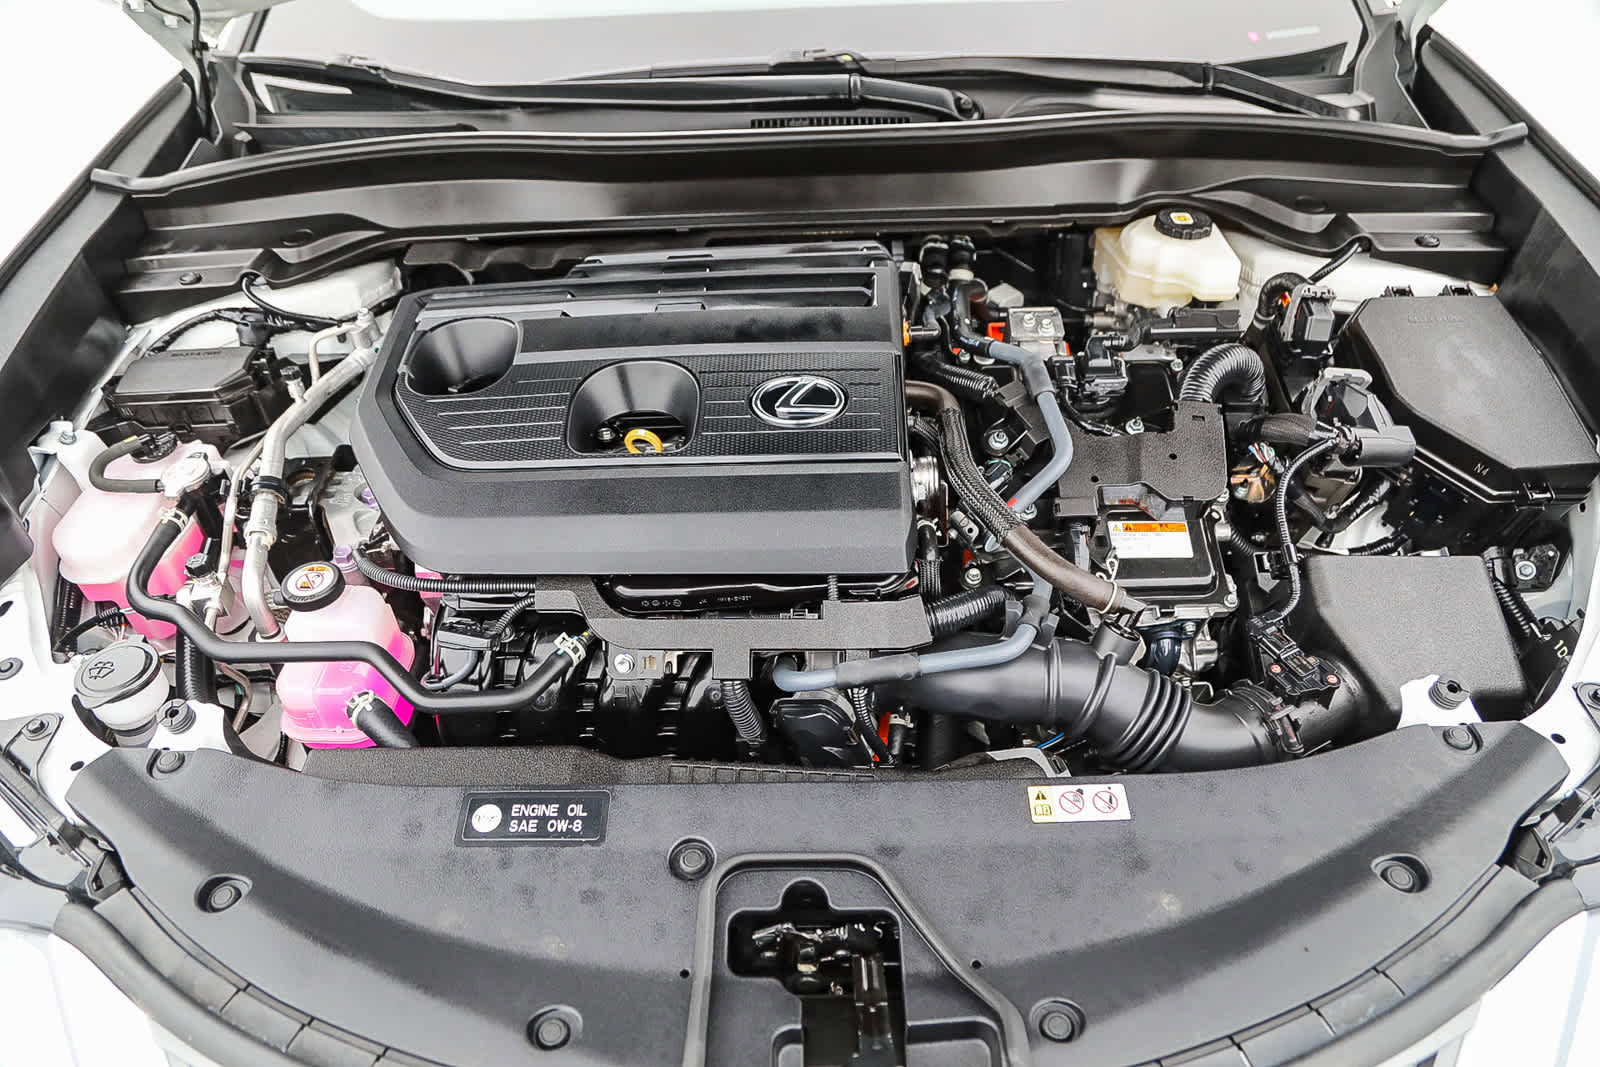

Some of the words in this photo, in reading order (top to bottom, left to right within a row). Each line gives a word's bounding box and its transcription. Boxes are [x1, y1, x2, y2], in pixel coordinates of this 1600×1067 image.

[511, 803, 559, 817] ENGINE
[567, 803, 588, 817] OIL
[508, 819, 538, 833] SAE
[547, 819, 583, 833] 0W-8
